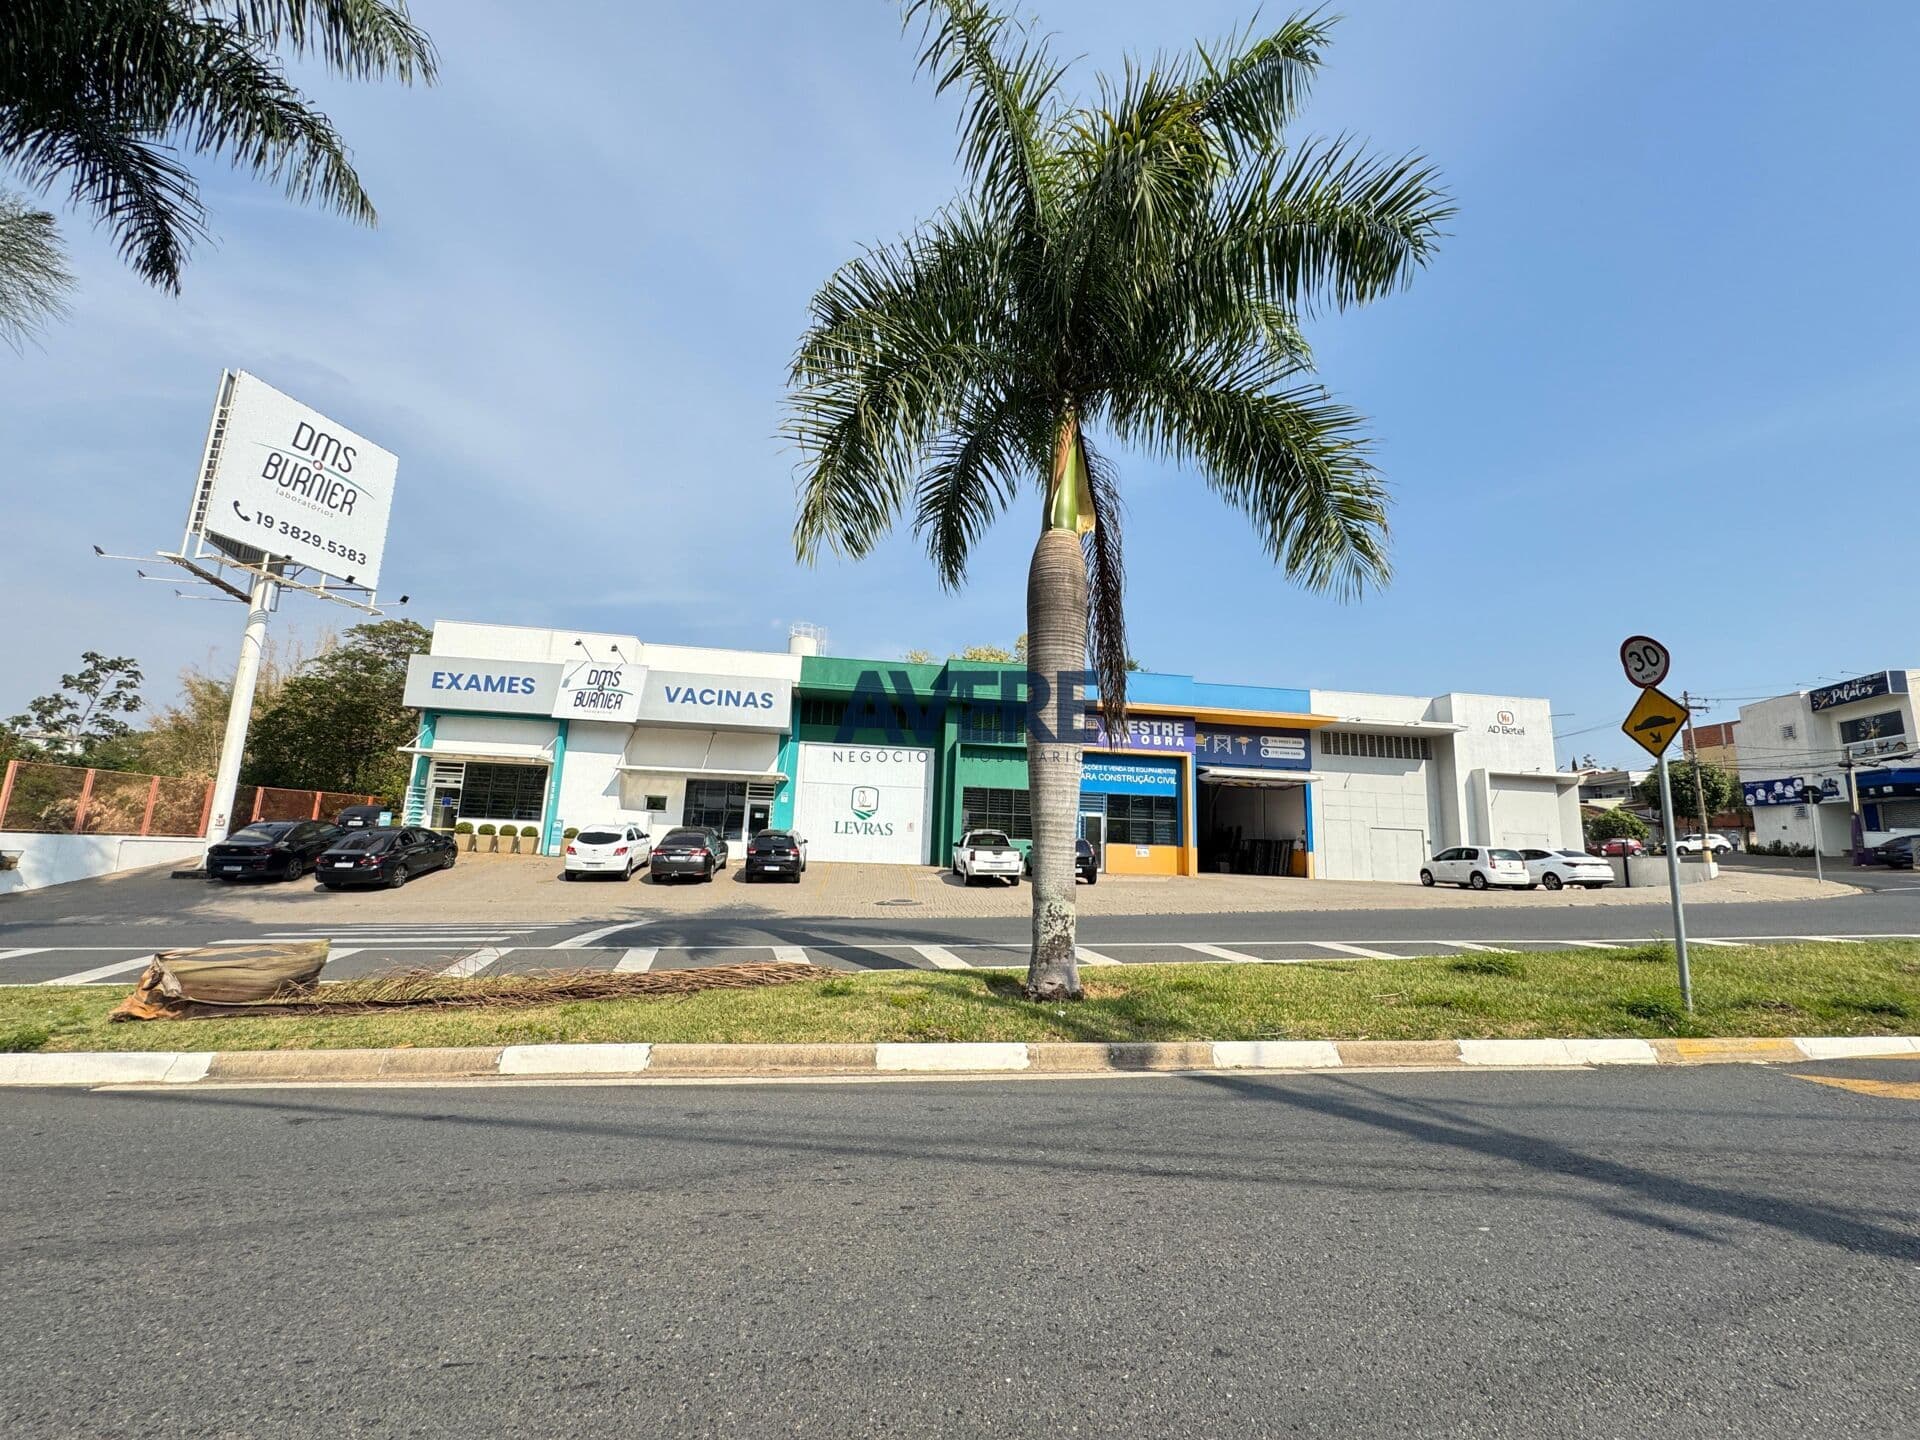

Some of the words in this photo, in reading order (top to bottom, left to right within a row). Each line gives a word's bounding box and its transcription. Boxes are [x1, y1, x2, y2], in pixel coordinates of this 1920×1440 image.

[291, 421, 358, 474] DMS
[261, 452, 358, 517] BURNIER
[255, 510, 275, 530] 19
[278, 520, 368, 566] 3829.5383
[1628, 645, 1660, 673] 30
[431, 671, 536, 695] EXAMES
[586, 669, 623, 687] DMS
[573, 691, 624, 710] BURNIER
[665, 686, 774, 710] VACINAS
[1830, 683, 1876, 705] Pilates
[1141, 736, 1185, 747] OBRA
[1487, 725, 1500, 734] AD
[1502, 725, 1525, 736] Betel
[1080, 773, 1097, 781] ARA
[1098, 773, 1156, 785] CONSTRUÇÃO
[1157, 776, 1177, 785] CIVIL
[833, 820, 894, 837] LEVRAS
